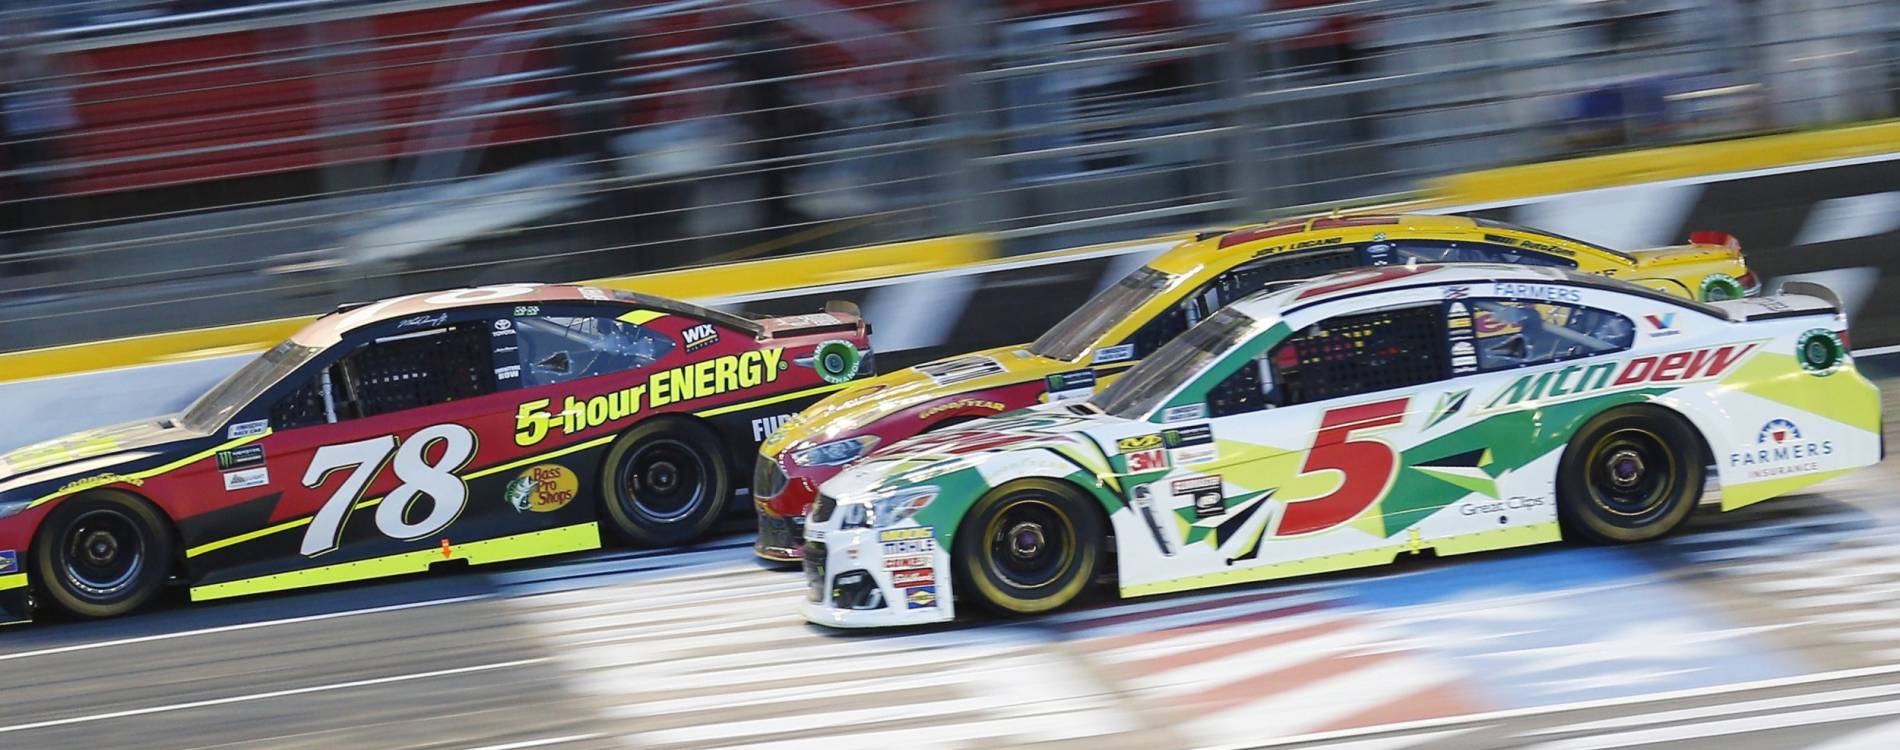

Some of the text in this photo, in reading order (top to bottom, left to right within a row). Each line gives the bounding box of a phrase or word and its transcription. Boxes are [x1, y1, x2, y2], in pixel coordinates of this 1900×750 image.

[1494, 281, 1582, 302] FARMERS
[682, 323, 715, 344] WIX
[824, 360, 861, 384] ETHANOL
[515, 348, 784, 446] 5-hour ENERGY
[919, 399, 1006, 419] GOODYEAR
[1130, 450, 1164, 472] 3M
[1729, 440, 1833, 468] FARMERS
[533, 467, 561, 481] Bass
[1276, 397, 1411, 536] 5
[1747, 461, 1819, 478] INSURANCE
[301, 423, 478, 558] 78
[537, 480, 557, 493] Pro
[537, 490, 572, 506] Shops
[1461, 496, 1545, 516] Great Clips
